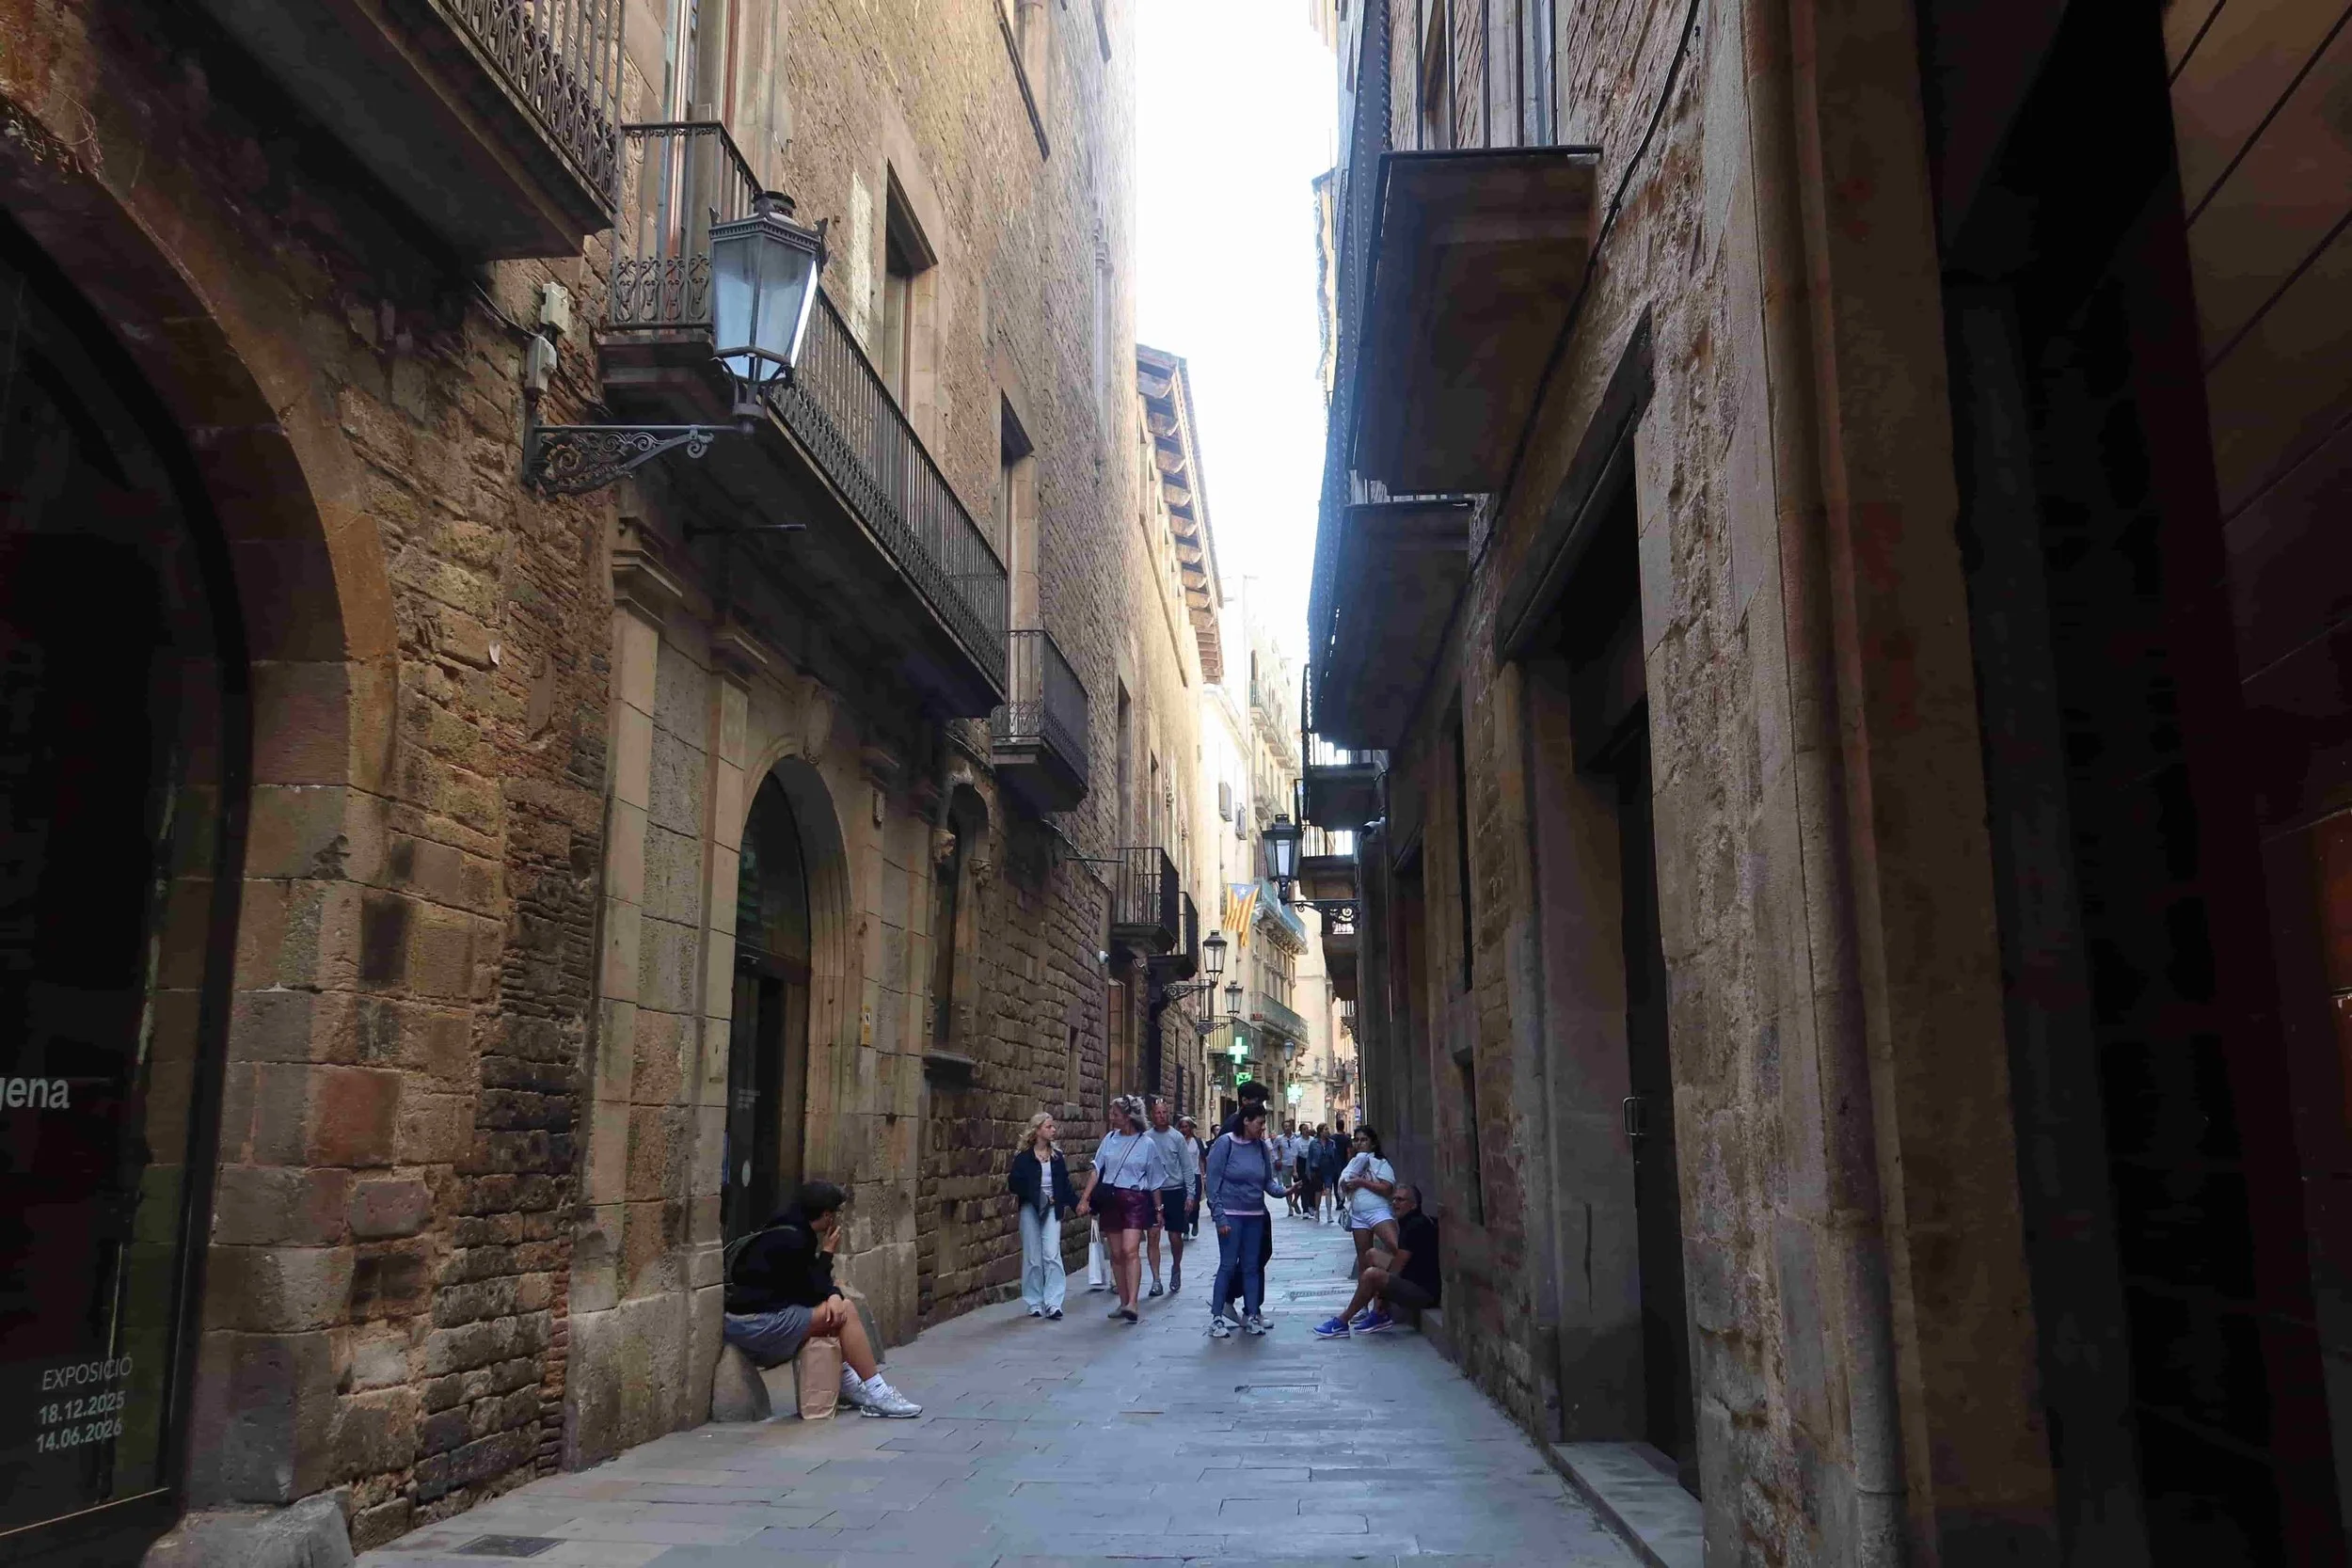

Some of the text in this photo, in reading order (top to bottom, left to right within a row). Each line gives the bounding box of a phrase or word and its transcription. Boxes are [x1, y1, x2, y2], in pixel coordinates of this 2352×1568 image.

[41, 1352, 134, 1391] EXPOSICIÓ
[39, 1390, 126, 1425] 18.12.2025
[36, 1418, 123, 1453] 14.06.2026
